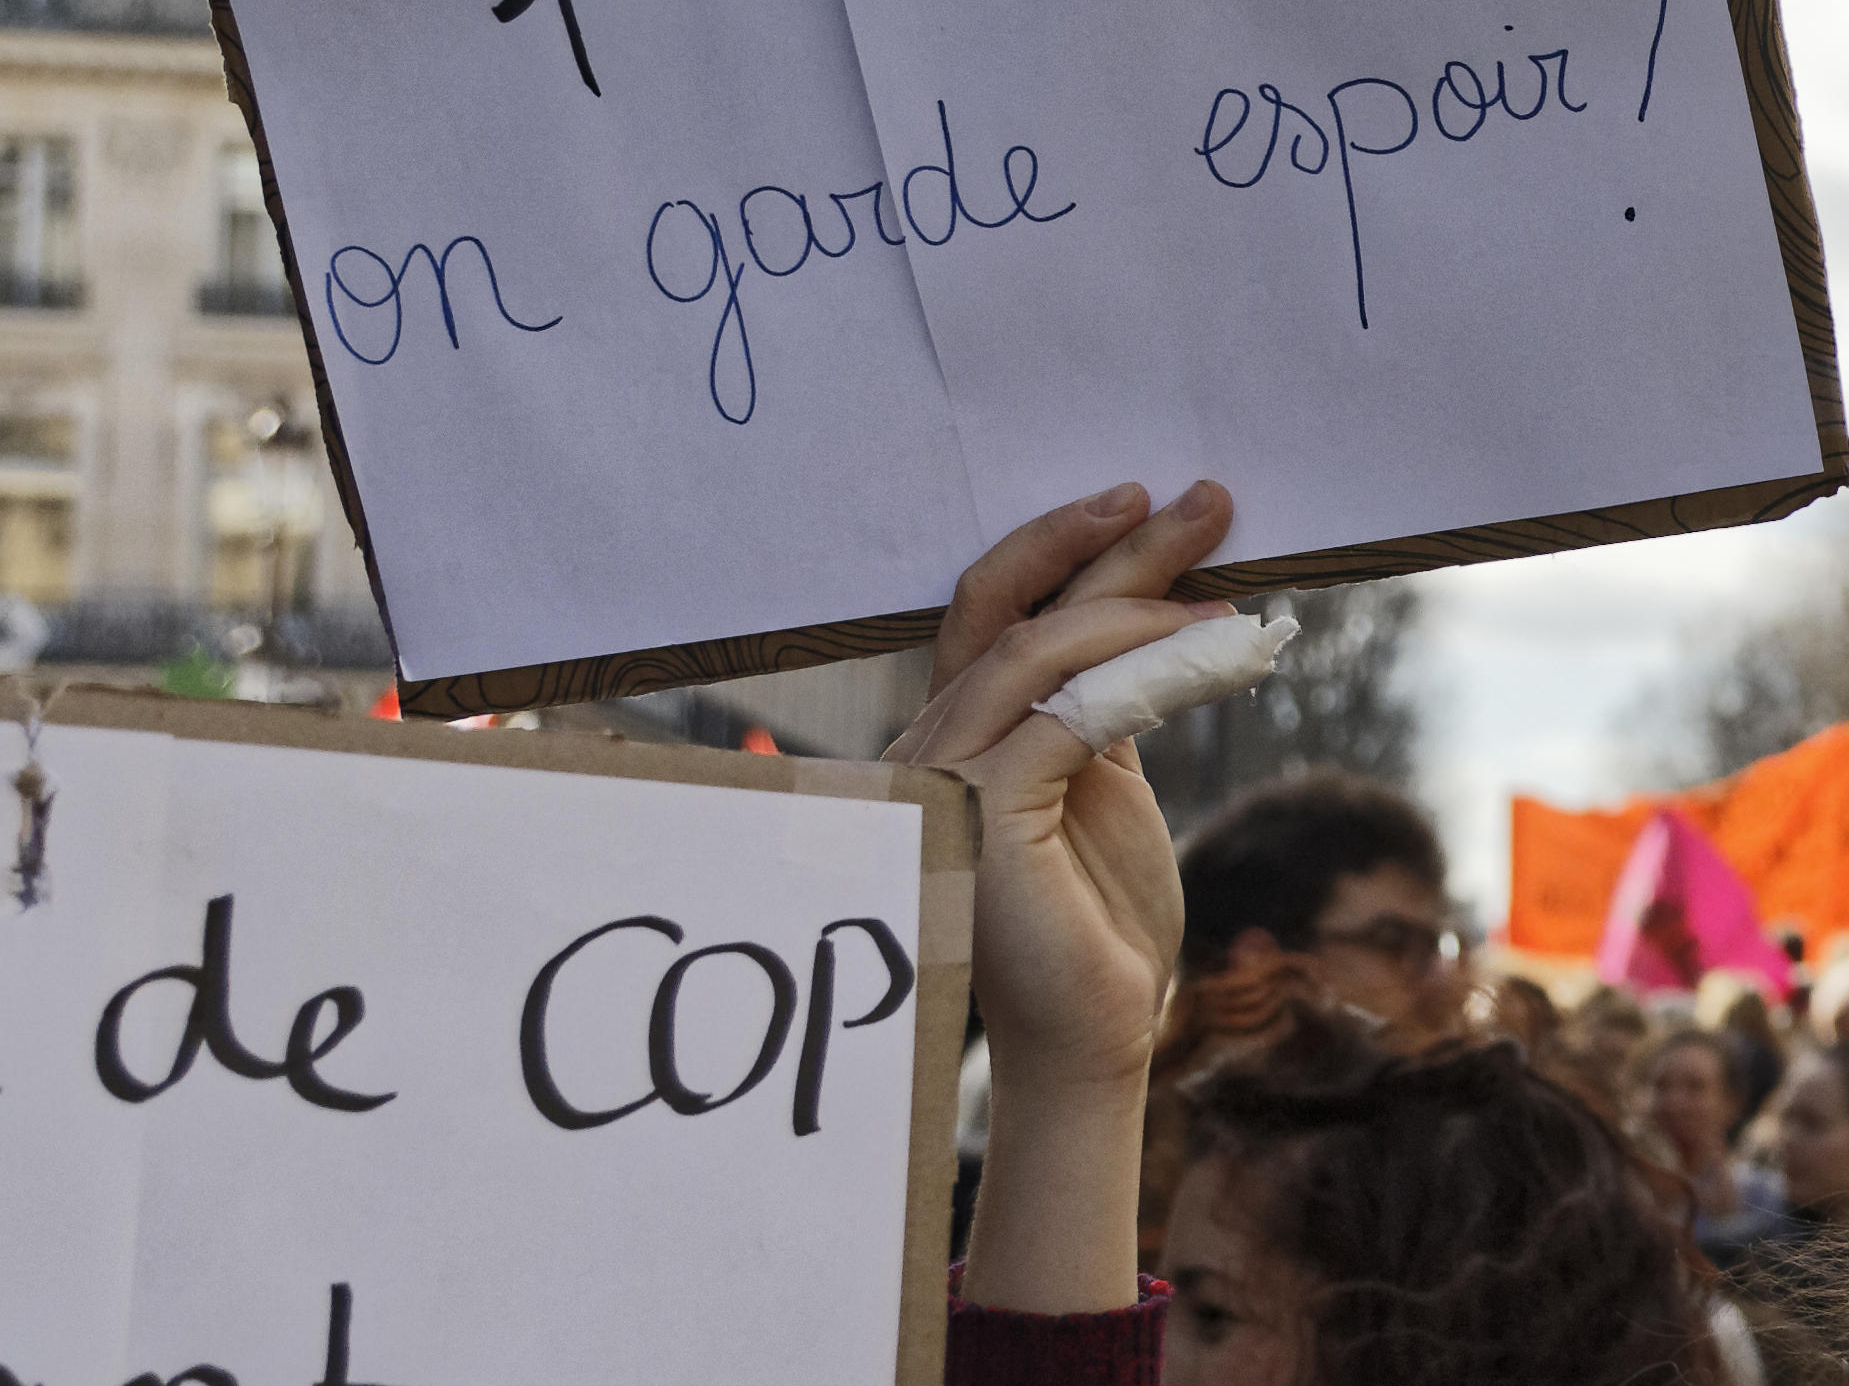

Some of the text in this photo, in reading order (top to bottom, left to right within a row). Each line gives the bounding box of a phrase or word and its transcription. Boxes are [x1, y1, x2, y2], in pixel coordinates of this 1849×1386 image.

[324, 233, 565, 367] on
[644, 97, 1078, 427] garde
[94, 894, 915, 1138] de COP
